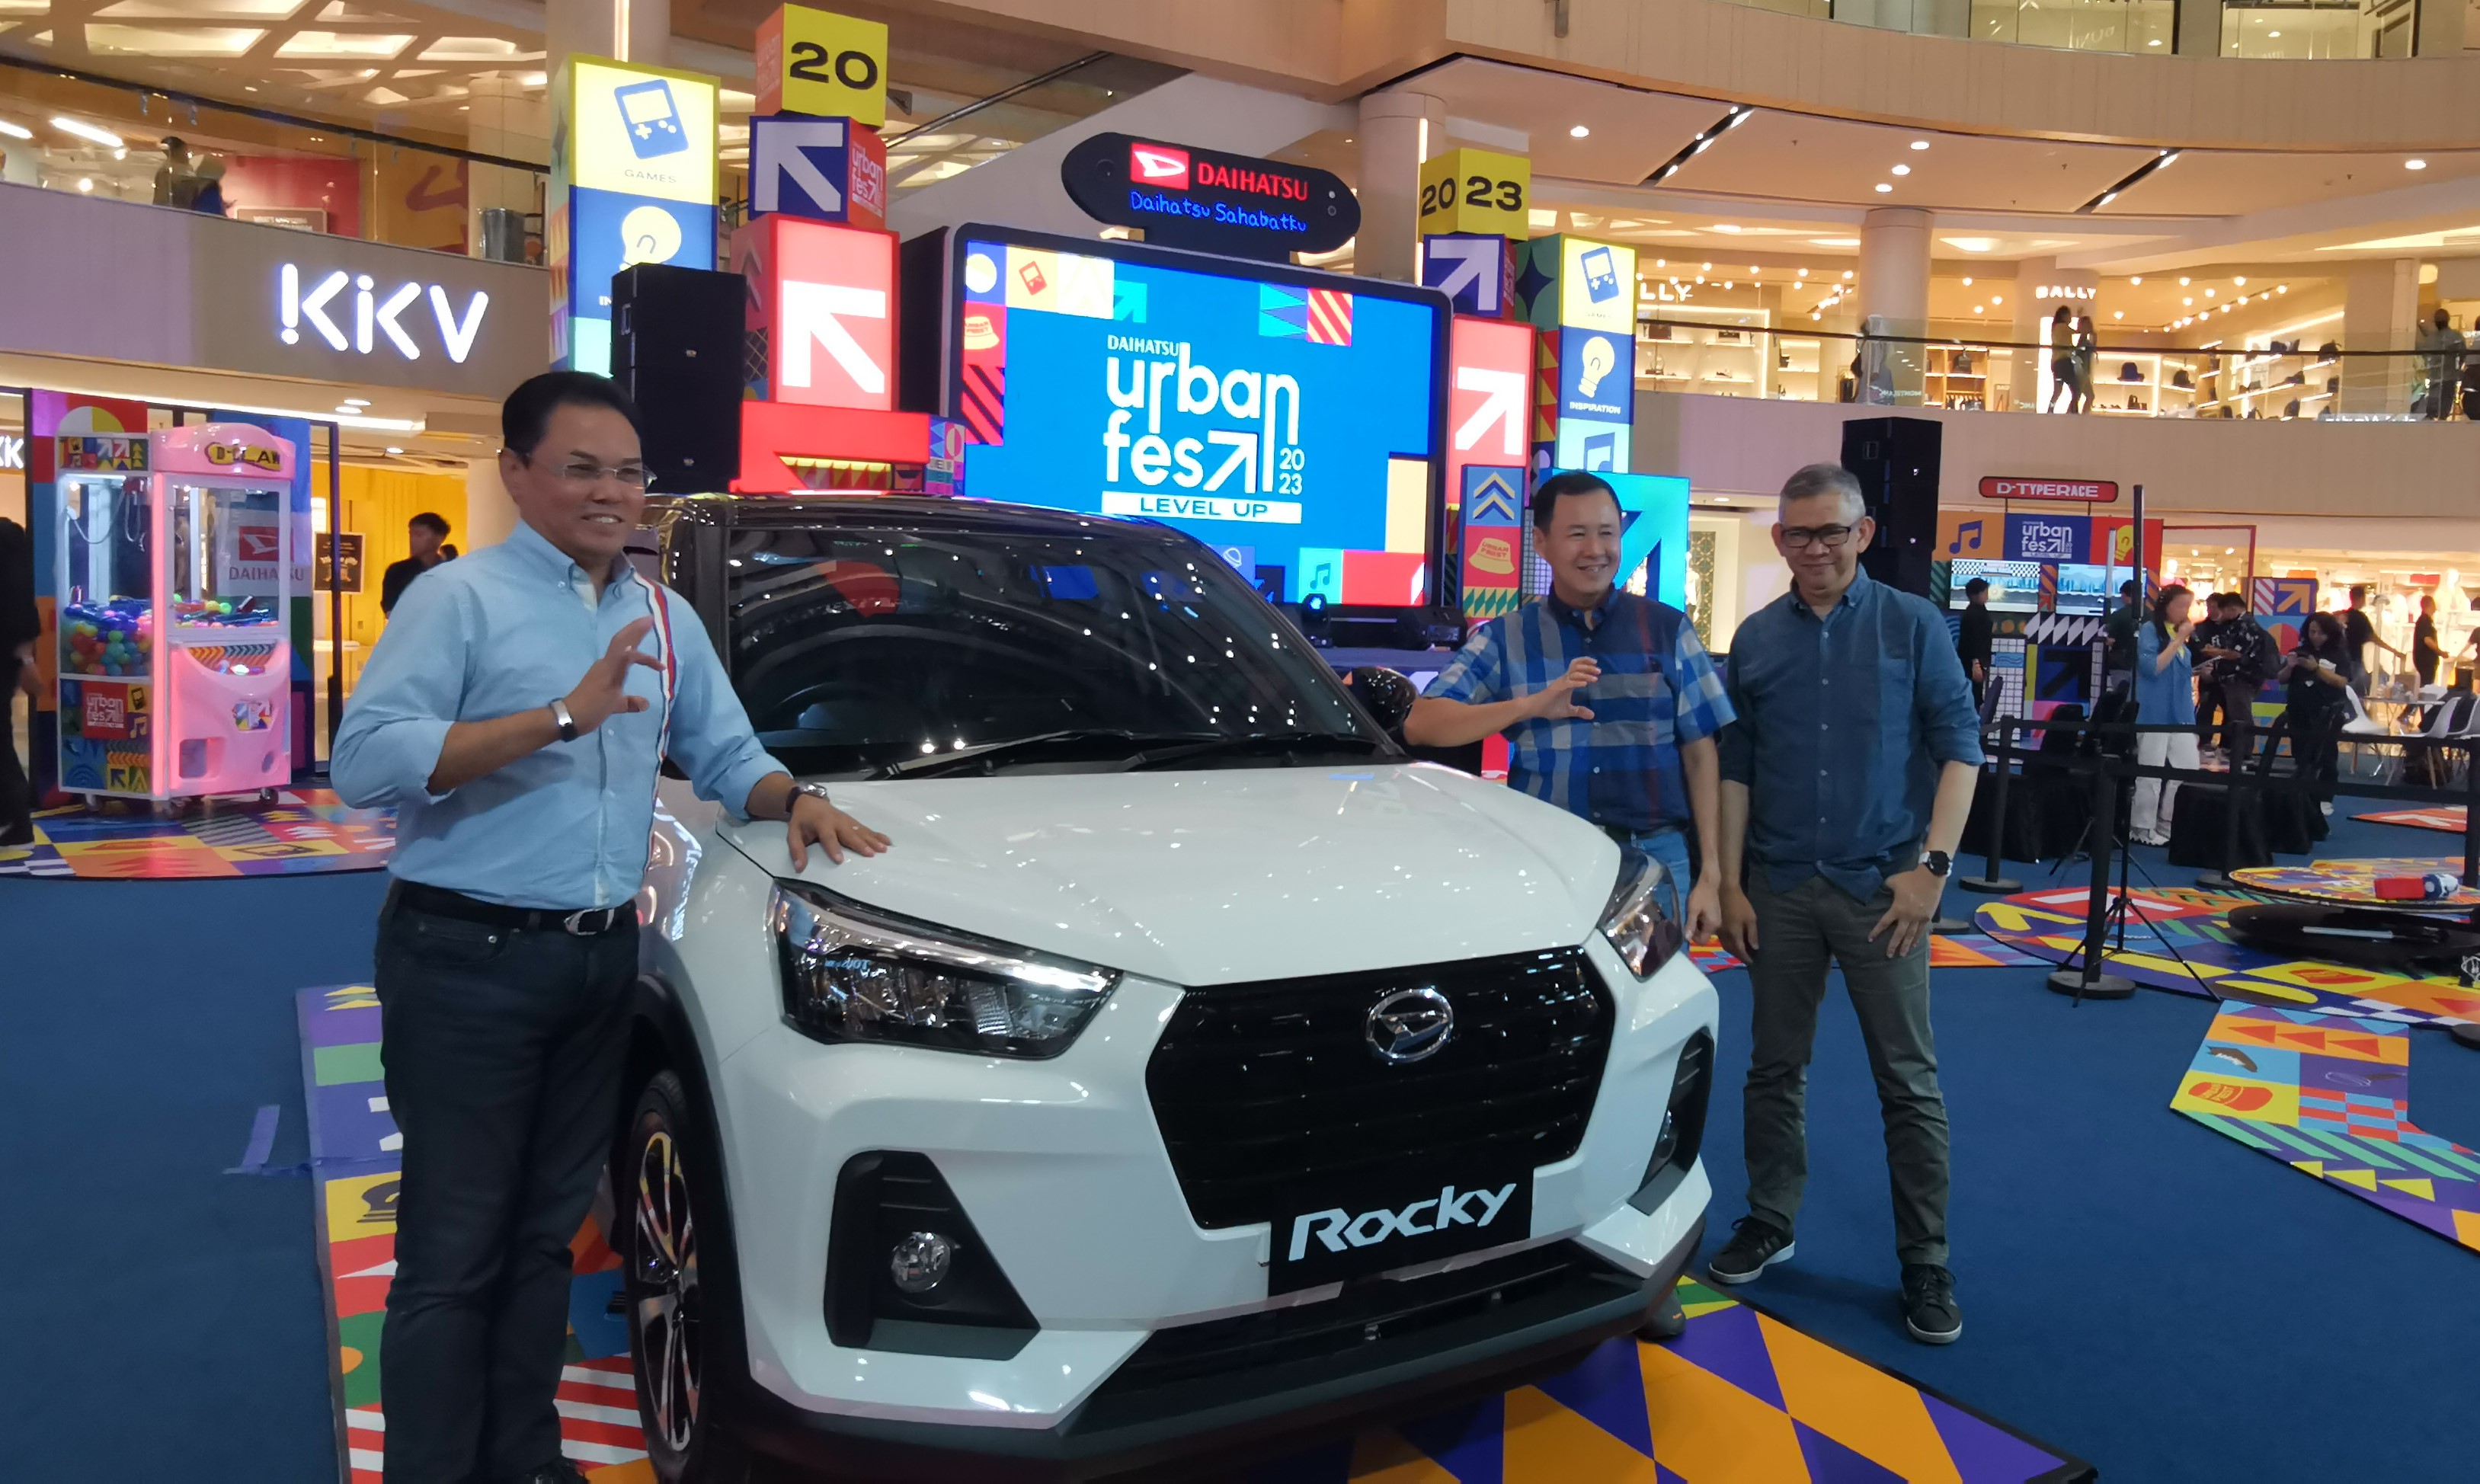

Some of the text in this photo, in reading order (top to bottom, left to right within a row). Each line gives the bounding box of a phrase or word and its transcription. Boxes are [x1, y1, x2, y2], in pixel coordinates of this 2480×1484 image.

[789, 41, 878, 91] 20
[625, 168, 677, 184] GAMES
[1198, 162, 1309, 201] DAIHATSU
[1131, 189, 1211, 218] Daihatsu
[1421, 178, 1456, 217] 20
[1466, 176, 1522, 212] 23
[1640, 282, 1692, 301] LLY
[2035, 286, 2097, 300] BALLY
[1107, 334, 1180, 357] DAIHATSU
[1106, 342, 1300, 446] urban
[1570, 401, 1621, 415] INSPIRATION
[1279, 447, 1305, 471] 20
[1278, 472, 1303, 495] 23
[1141, 497, 1269, 518] LEVEL UP
[2022, 521, 2072, 542] urban
[229, 566, 304, 580] DAIHAU
